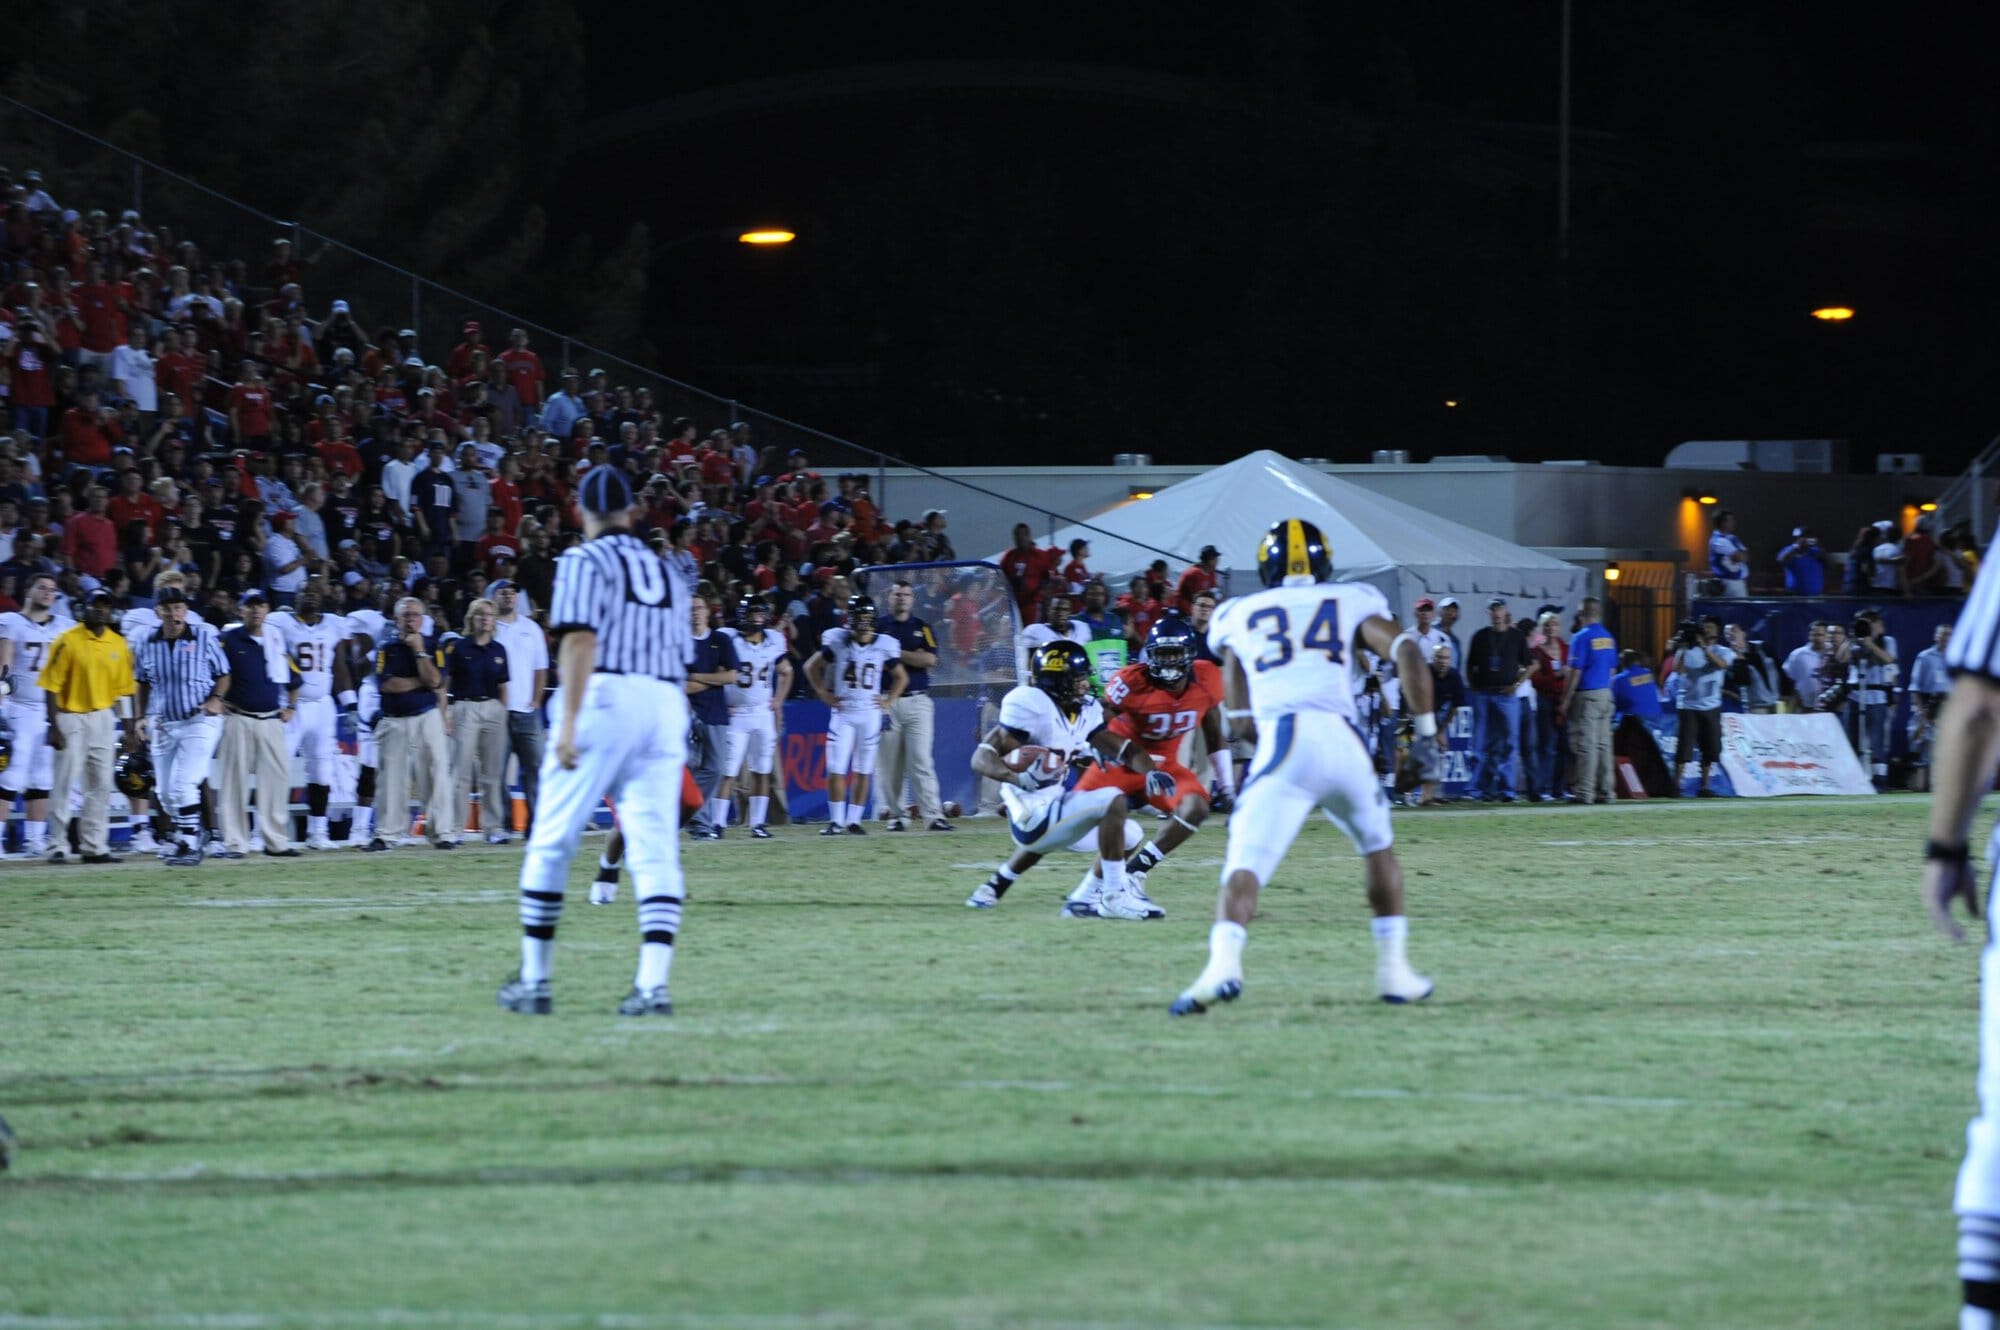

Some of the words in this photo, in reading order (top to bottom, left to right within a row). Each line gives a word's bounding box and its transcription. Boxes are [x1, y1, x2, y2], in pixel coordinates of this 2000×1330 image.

[1247, 599, 1344, 673] 34
[24, 642, 51, 671] 7
[296, 642, 325, 671] 61
[843, 661, 876, 690] 40
[1141, 710, 1199, 740] 32
